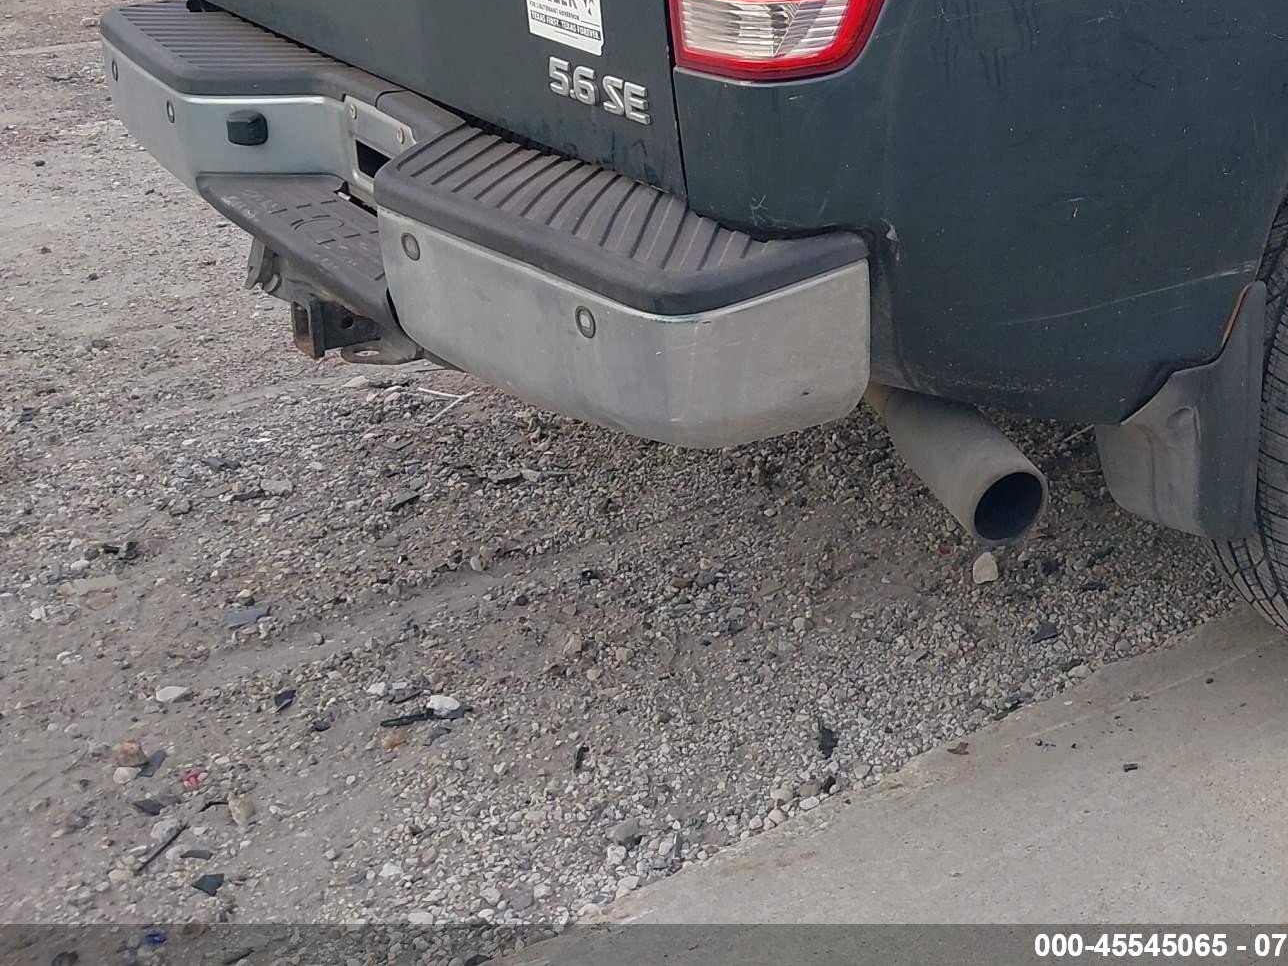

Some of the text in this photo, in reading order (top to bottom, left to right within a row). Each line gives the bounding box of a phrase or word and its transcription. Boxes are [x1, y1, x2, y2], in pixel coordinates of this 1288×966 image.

[531, 11, 546, 23] TEXAS
[561, 20, 577, 32] TEXAS
[548, 56, 651, 125] 5.6 SE
